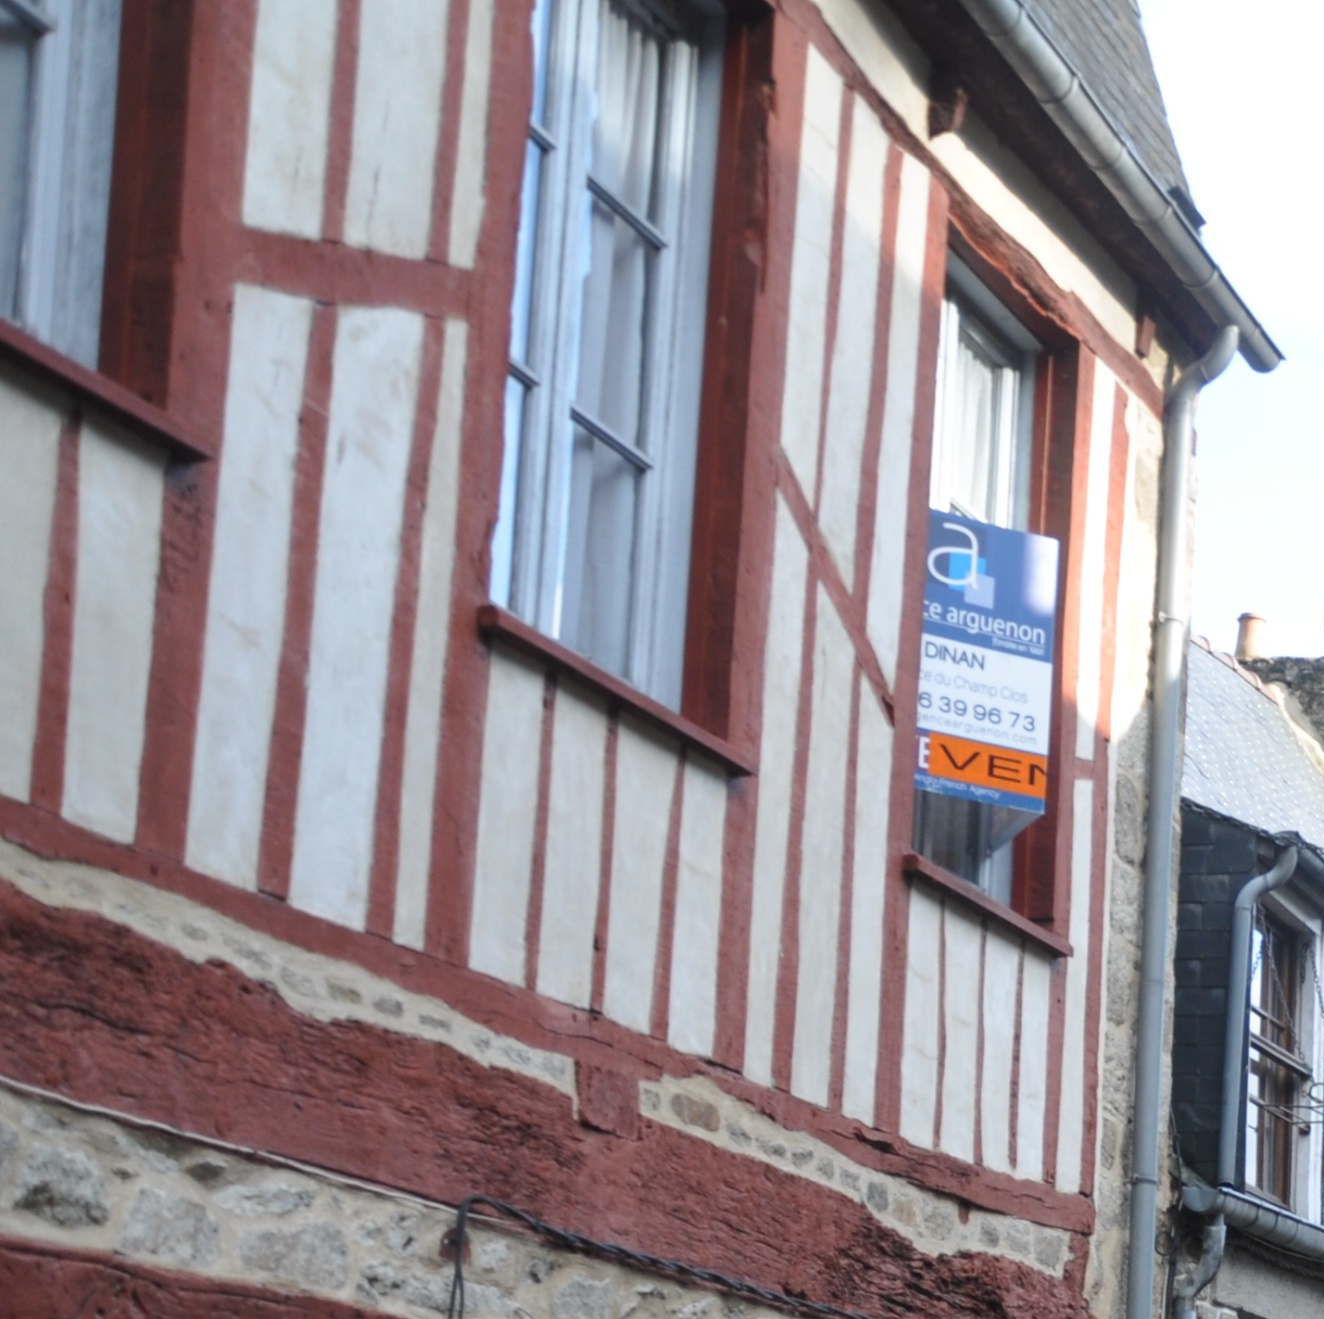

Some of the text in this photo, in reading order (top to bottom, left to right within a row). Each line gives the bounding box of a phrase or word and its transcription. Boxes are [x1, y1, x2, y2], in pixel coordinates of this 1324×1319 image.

[946, 606, 1046, 645] arguenon
[924, 641, 985, 671] DINAN
[934, 672, 950, 686] du
[953, 675, 998, 699] Champ
[1000, 686, 1029, 704] Clos
[938, 696, 968, 717] 39
[973, 704, 1002, 725] 96
[1009, 710, 1036, 733] 73
